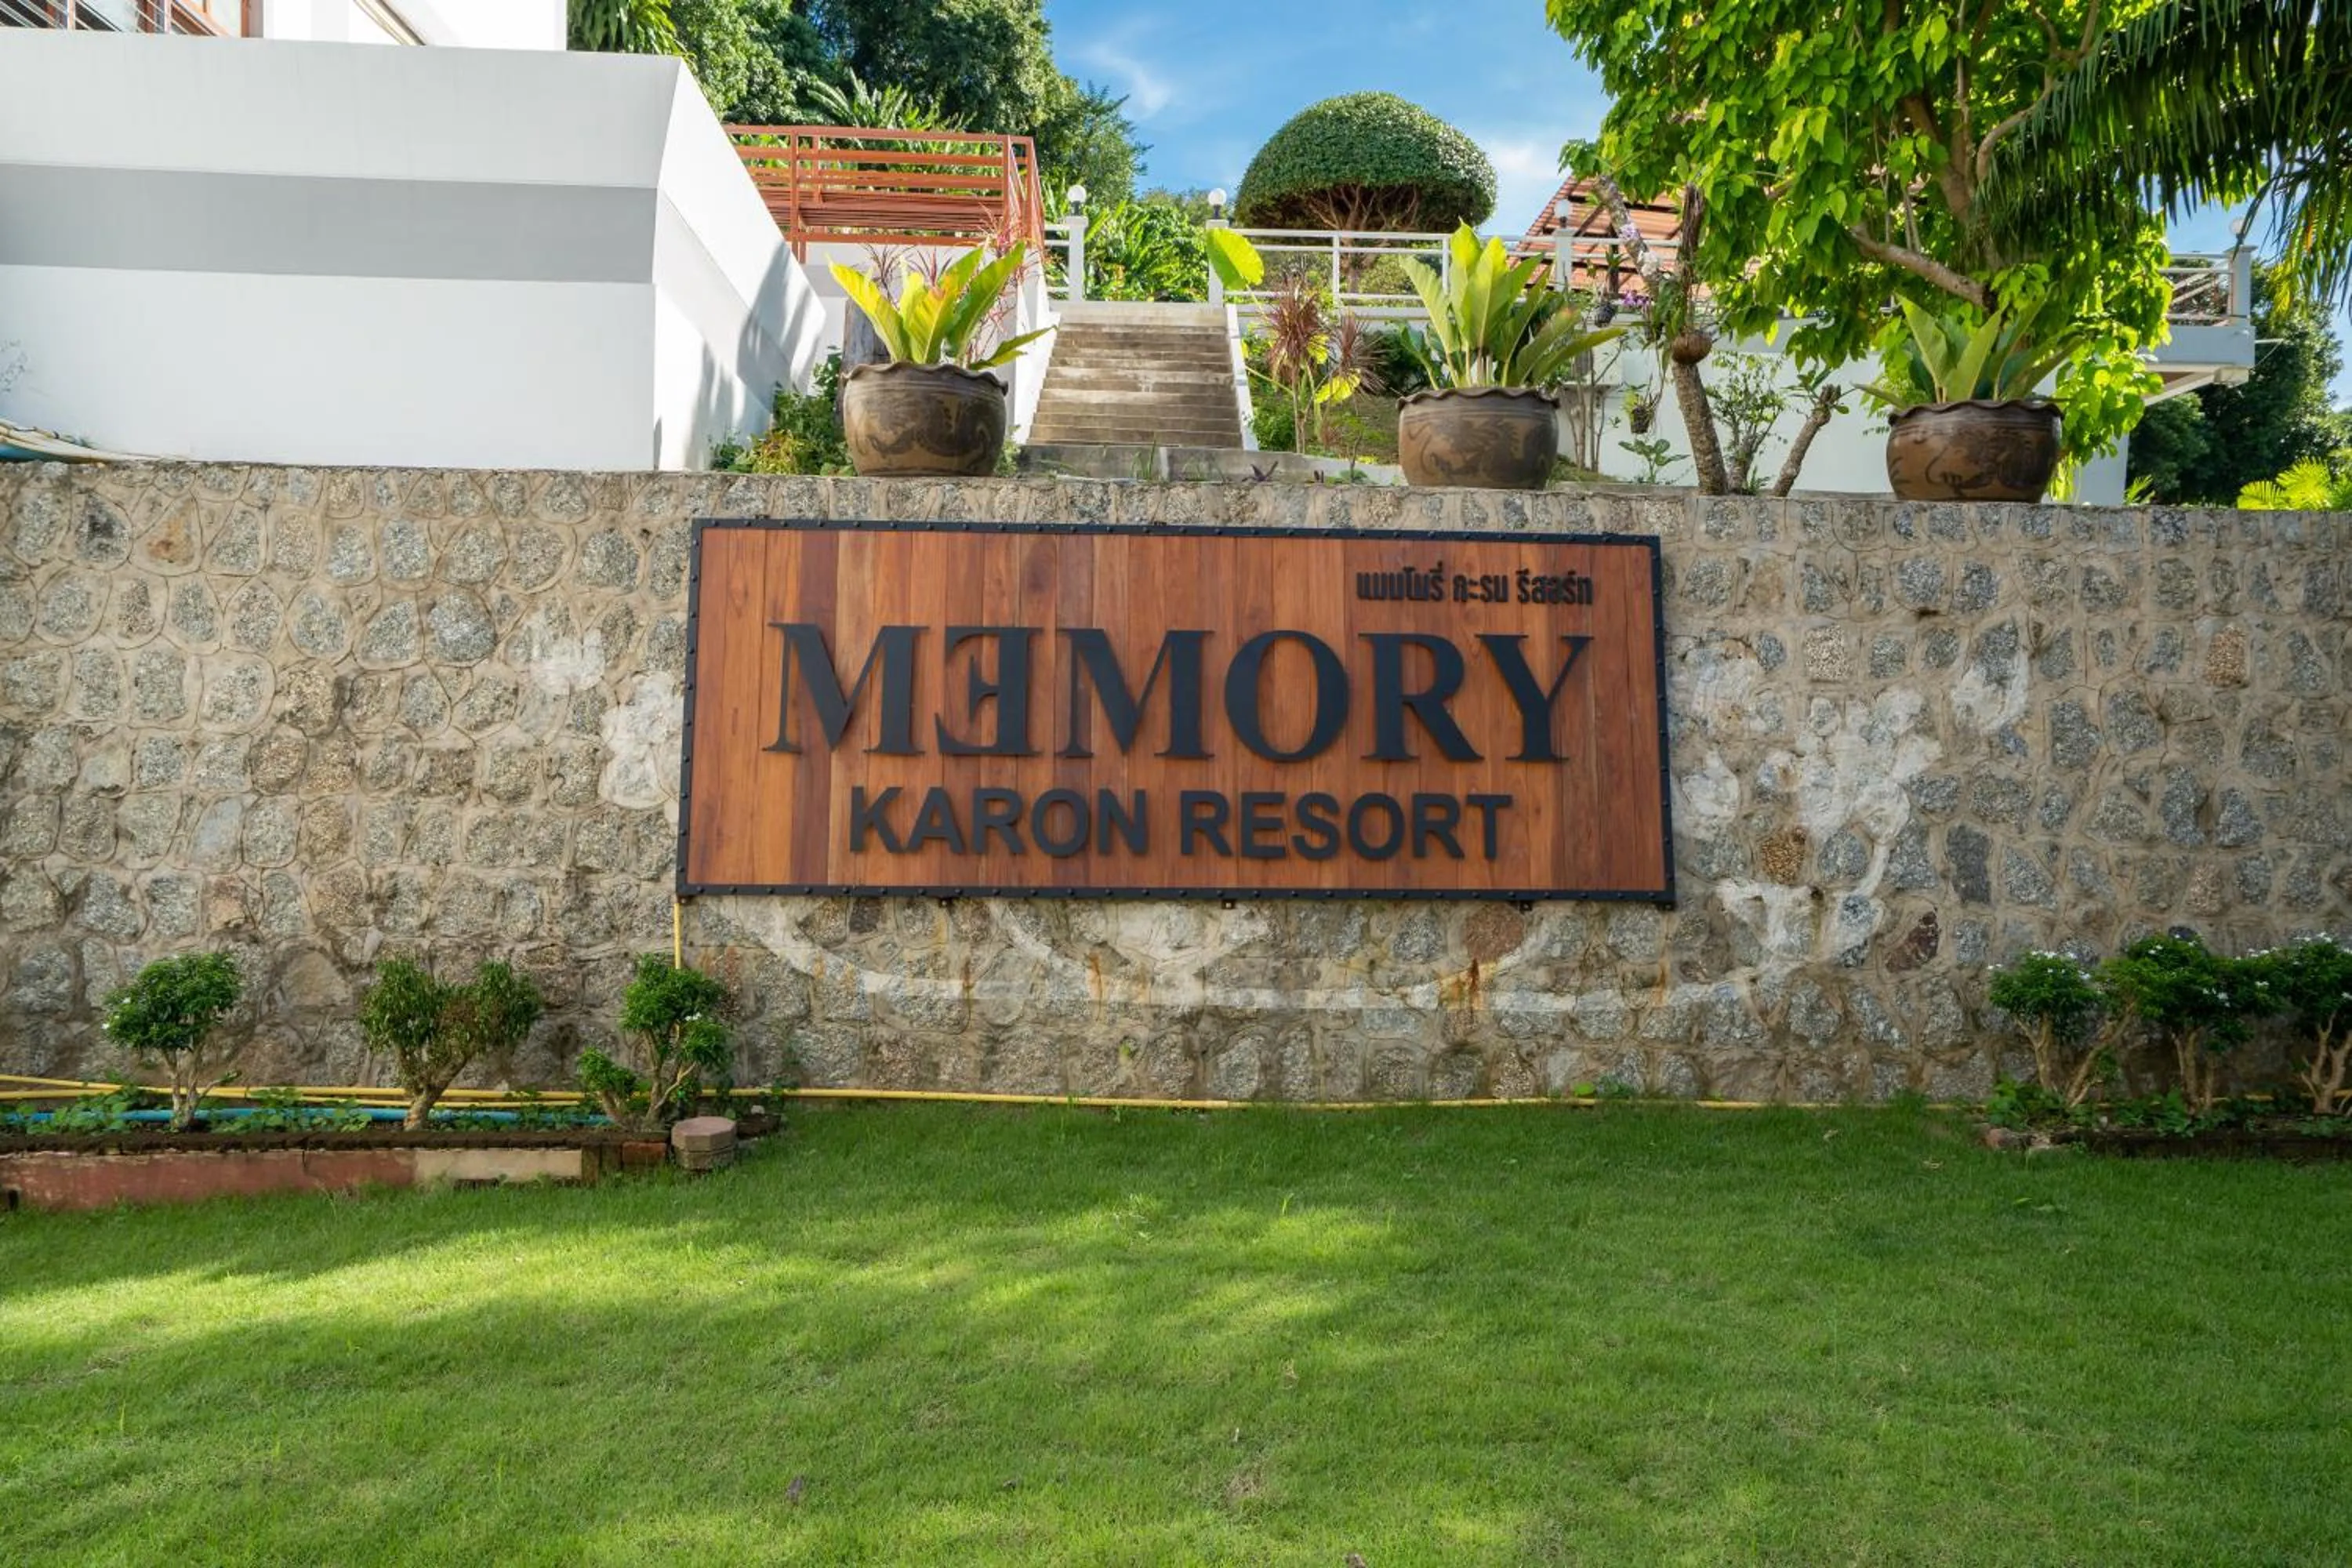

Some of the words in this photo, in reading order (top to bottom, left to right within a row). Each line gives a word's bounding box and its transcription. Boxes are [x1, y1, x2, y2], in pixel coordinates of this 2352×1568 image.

[1453, 573, 1508, 603] กะรน
[1515, 566, 1594, 605] รีสอร์ท
[760, 622, 1594, 763] MEMORY
[849, 785, 1149, 857] KARON
[1180, 790, 1512, 860] RESORT
